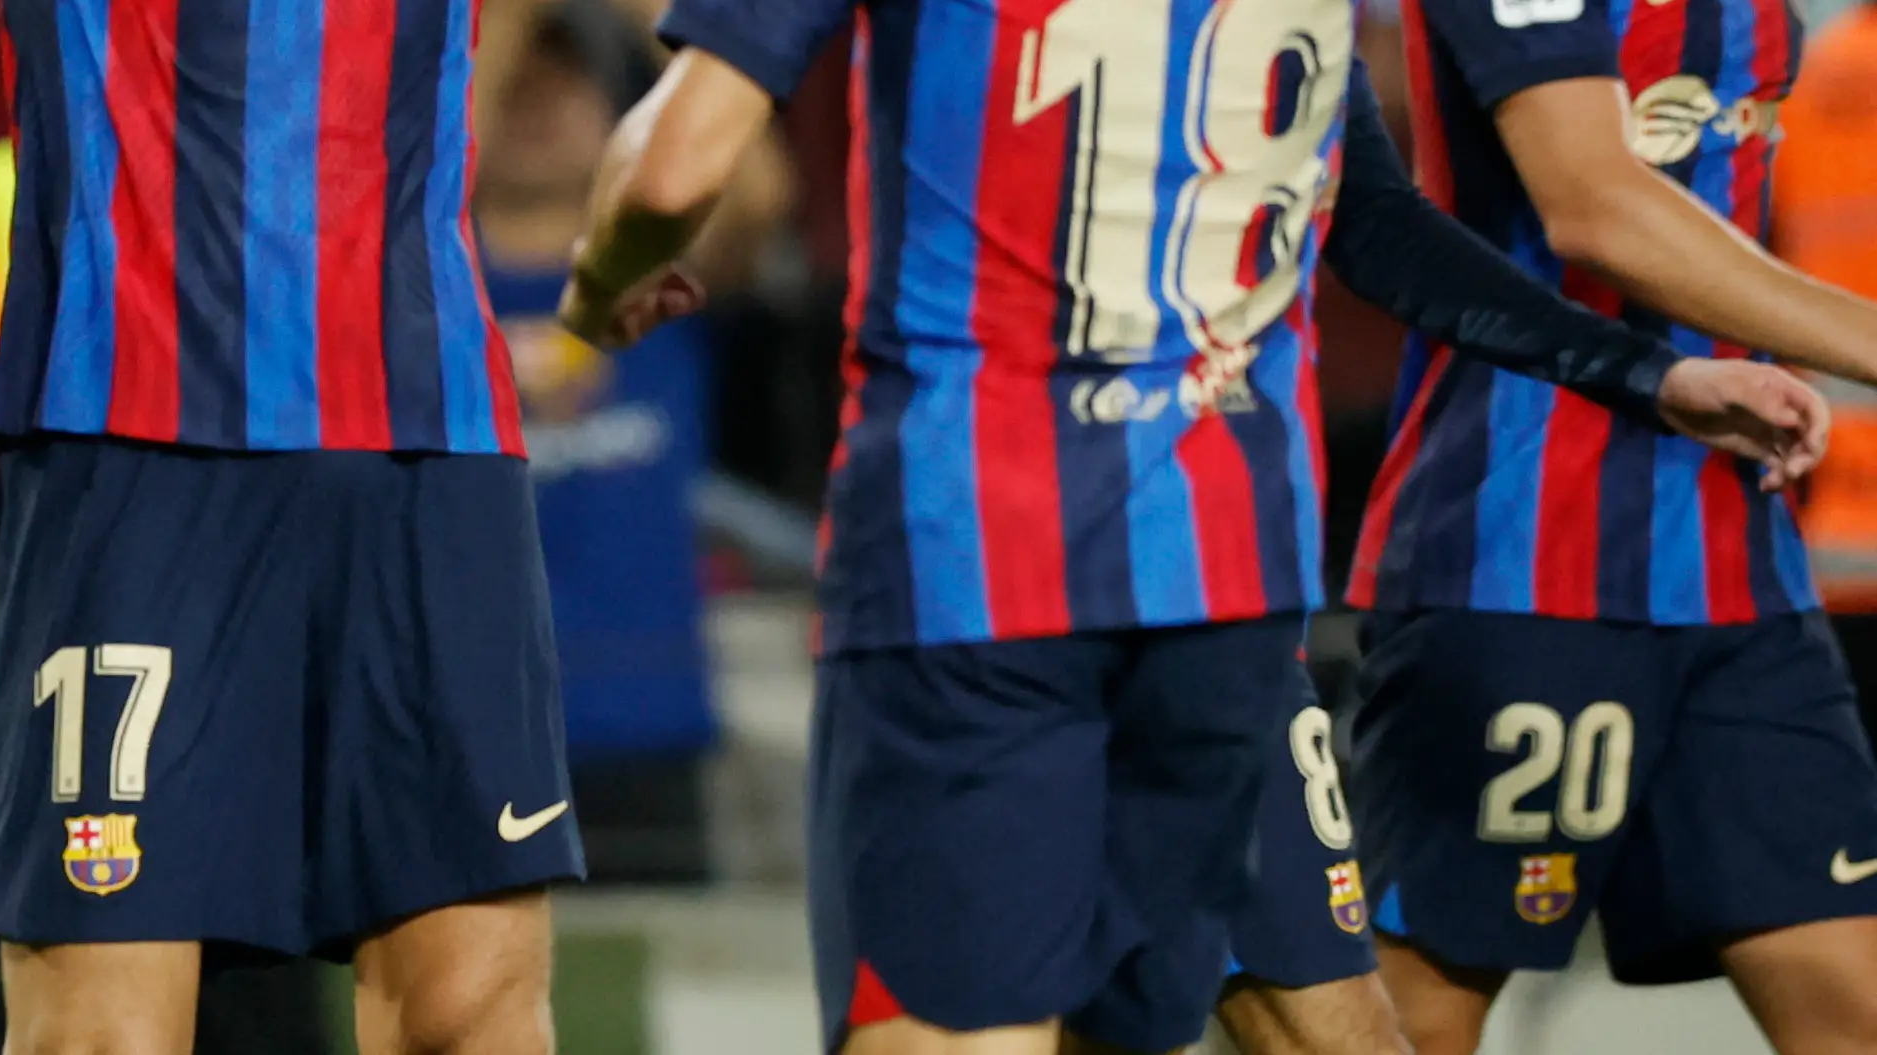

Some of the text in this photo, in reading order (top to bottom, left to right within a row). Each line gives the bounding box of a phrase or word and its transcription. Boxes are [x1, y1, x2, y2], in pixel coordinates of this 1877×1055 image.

[33, 643, 172, 803] 17
[1290, 706, 1353, 850] 8
[1477, 700, 1635, 843] 20
